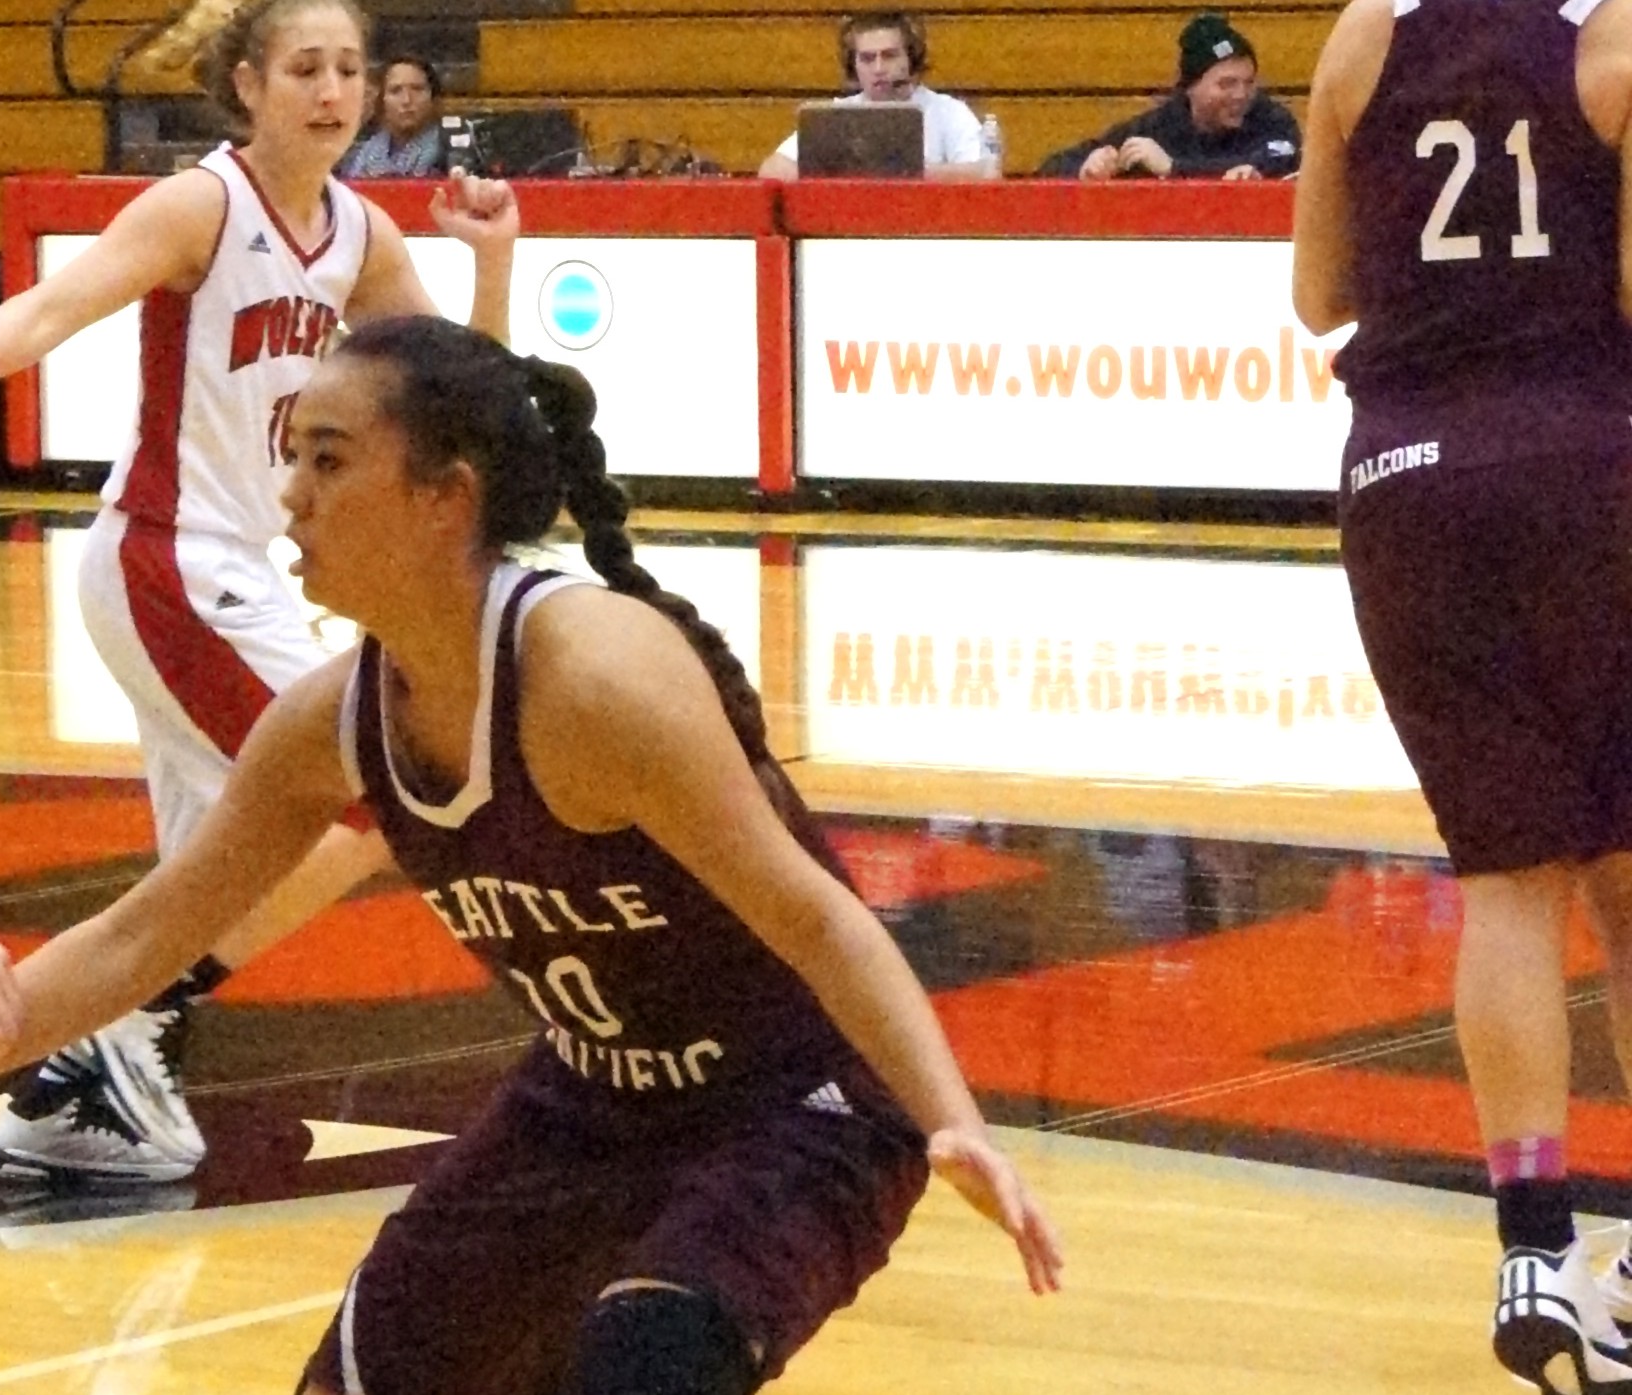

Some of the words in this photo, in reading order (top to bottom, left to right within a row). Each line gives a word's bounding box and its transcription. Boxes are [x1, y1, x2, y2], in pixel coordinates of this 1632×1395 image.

[1415, 119, 1551, 262] 21
[1350, 441, 1440, 495] FALCONS
[421, 876, 669, 939] EATTLE
[509, 955, 623, 1038] 10
